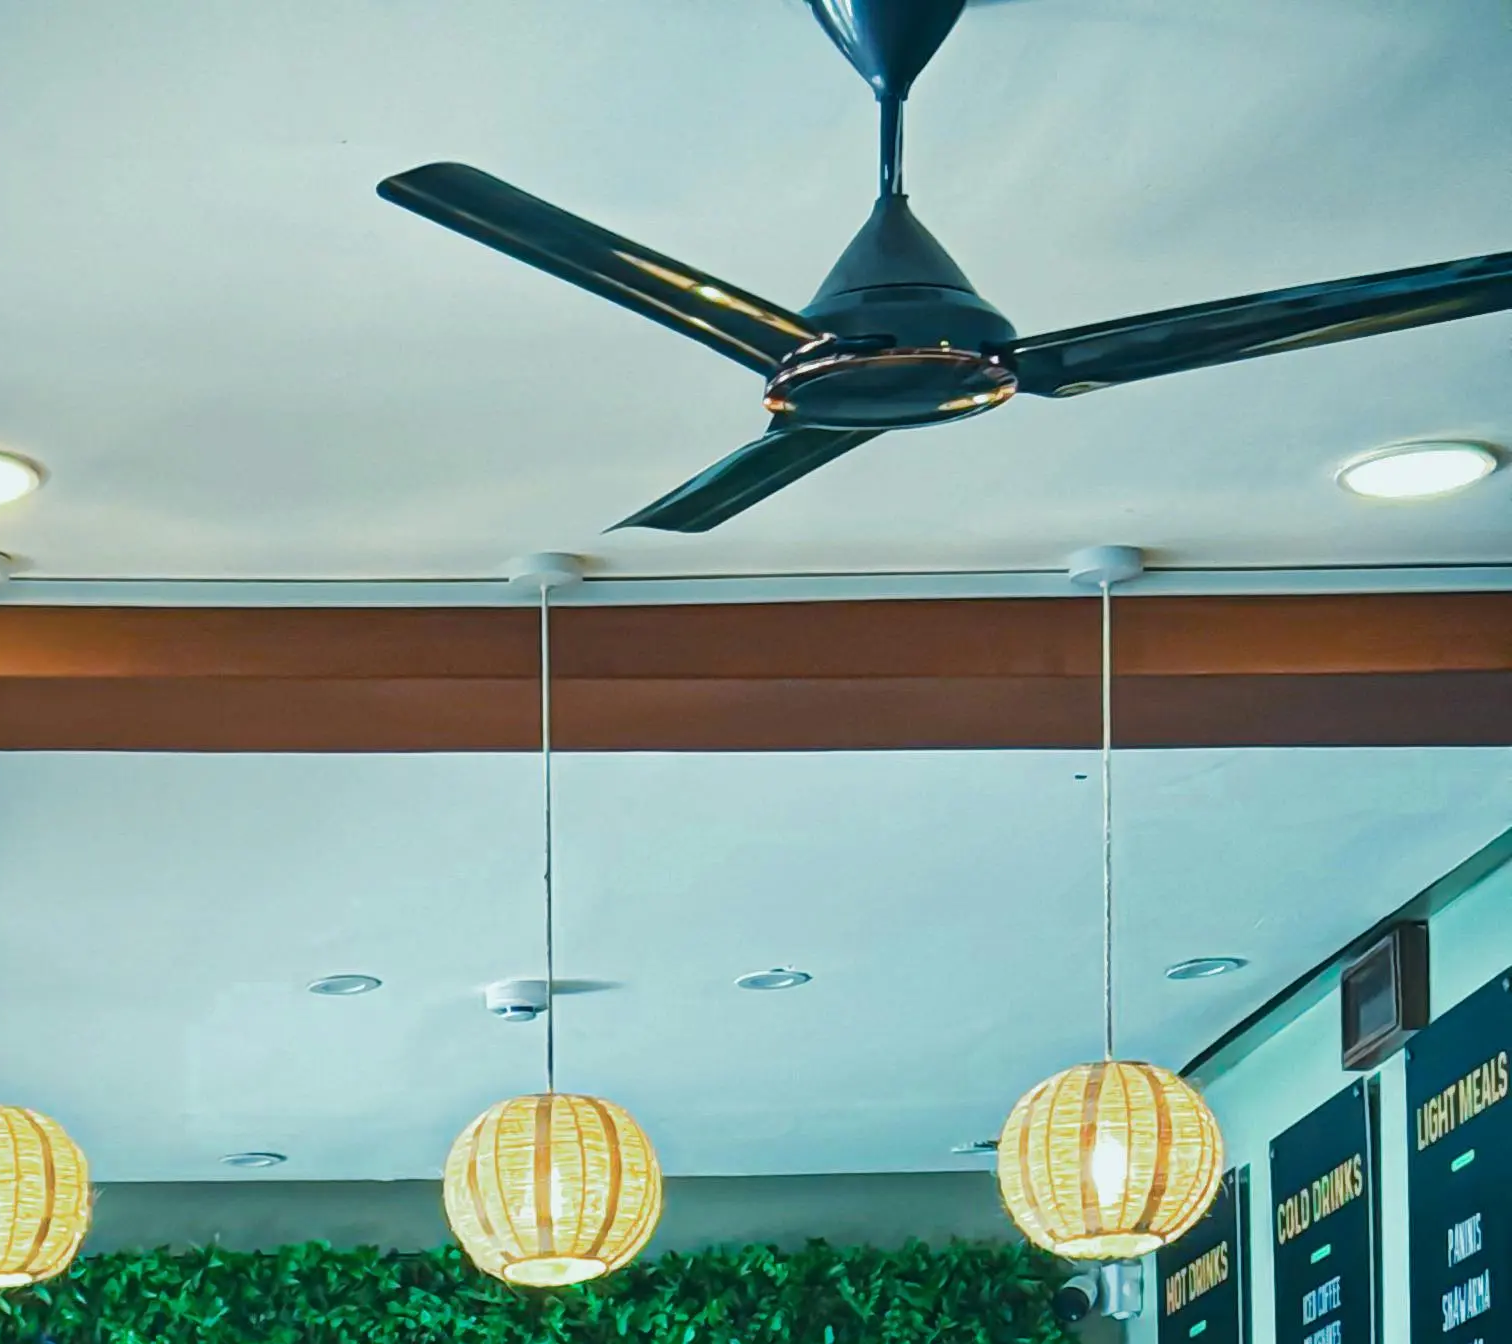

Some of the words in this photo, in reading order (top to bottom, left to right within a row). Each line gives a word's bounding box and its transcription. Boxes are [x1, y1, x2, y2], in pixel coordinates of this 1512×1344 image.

[1416, 1084, 1455, 1151] LIGHT
[1458, 1051, 1508, 1125] MEALS
[1277, 1188, 1309, 1245] COLD
[1312, 1153, 1363, 1223] DRINKS
[1166, 1266, 1187, 1316] HOT
[1189, 1241, 1228, 1301] DRINKS
